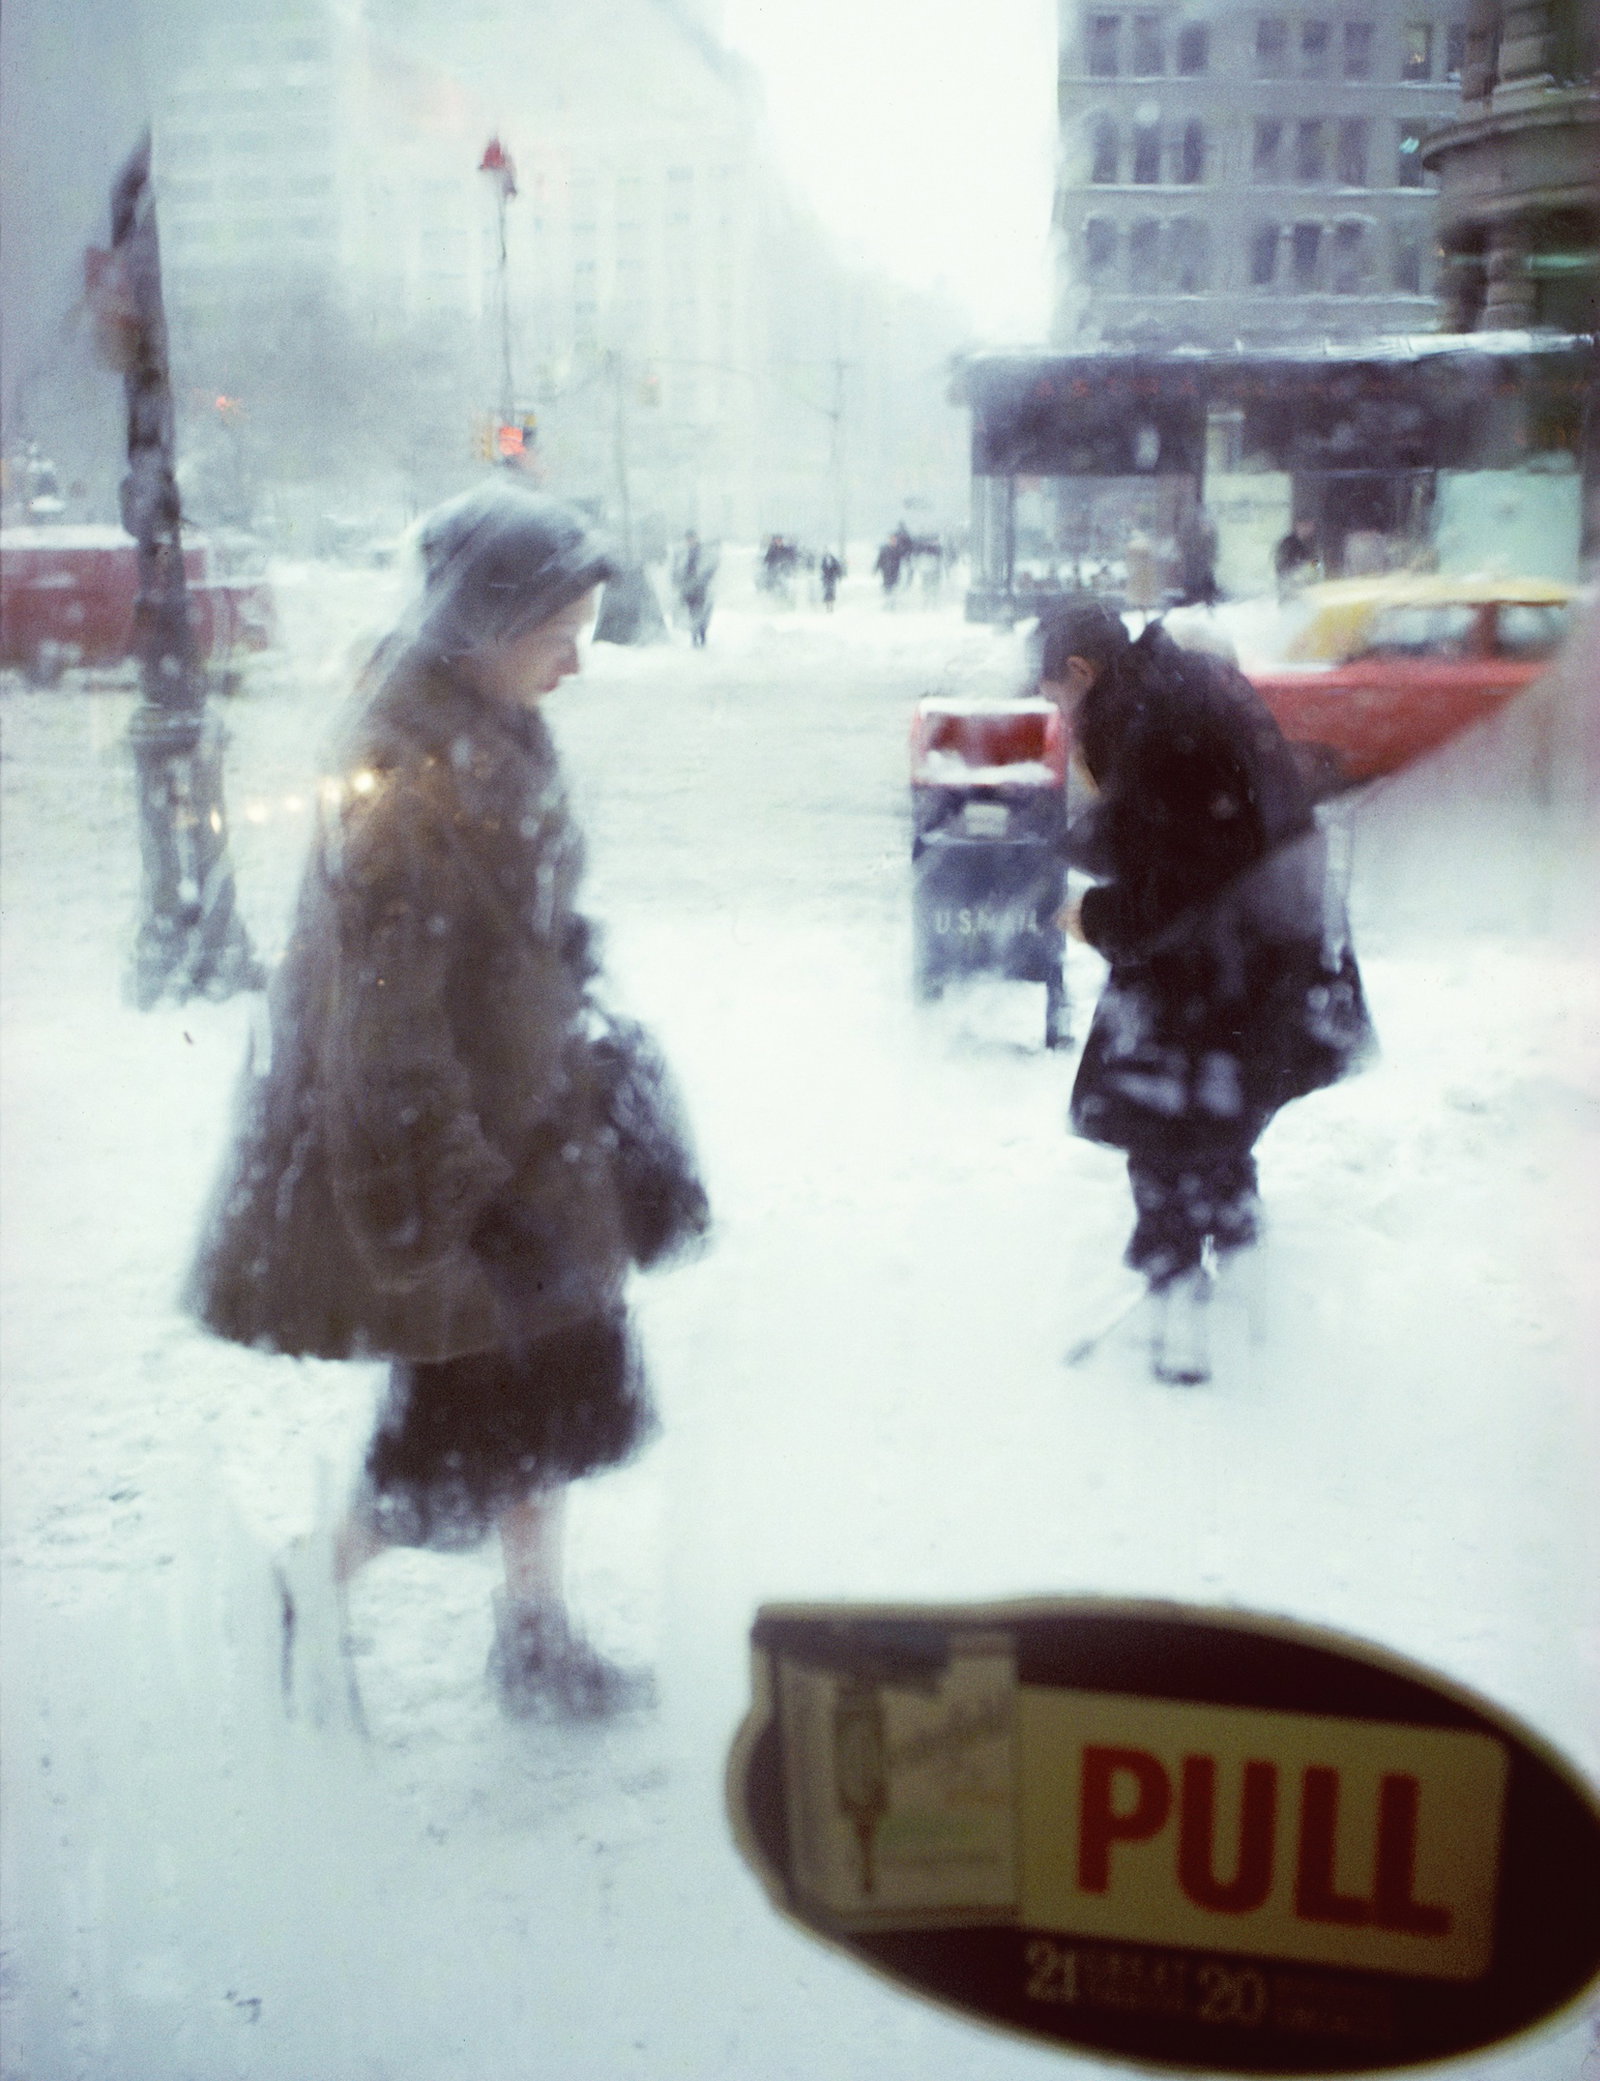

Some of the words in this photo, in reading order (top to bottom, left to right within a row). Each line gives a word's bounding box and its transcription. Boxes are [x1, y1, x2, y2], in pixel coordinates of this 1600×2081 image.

[1077, 1743, 1453, 1938] PULL
[1026, 1940, 1080, 2002] 21
[1199, 1963, 1266, 2025] 20
